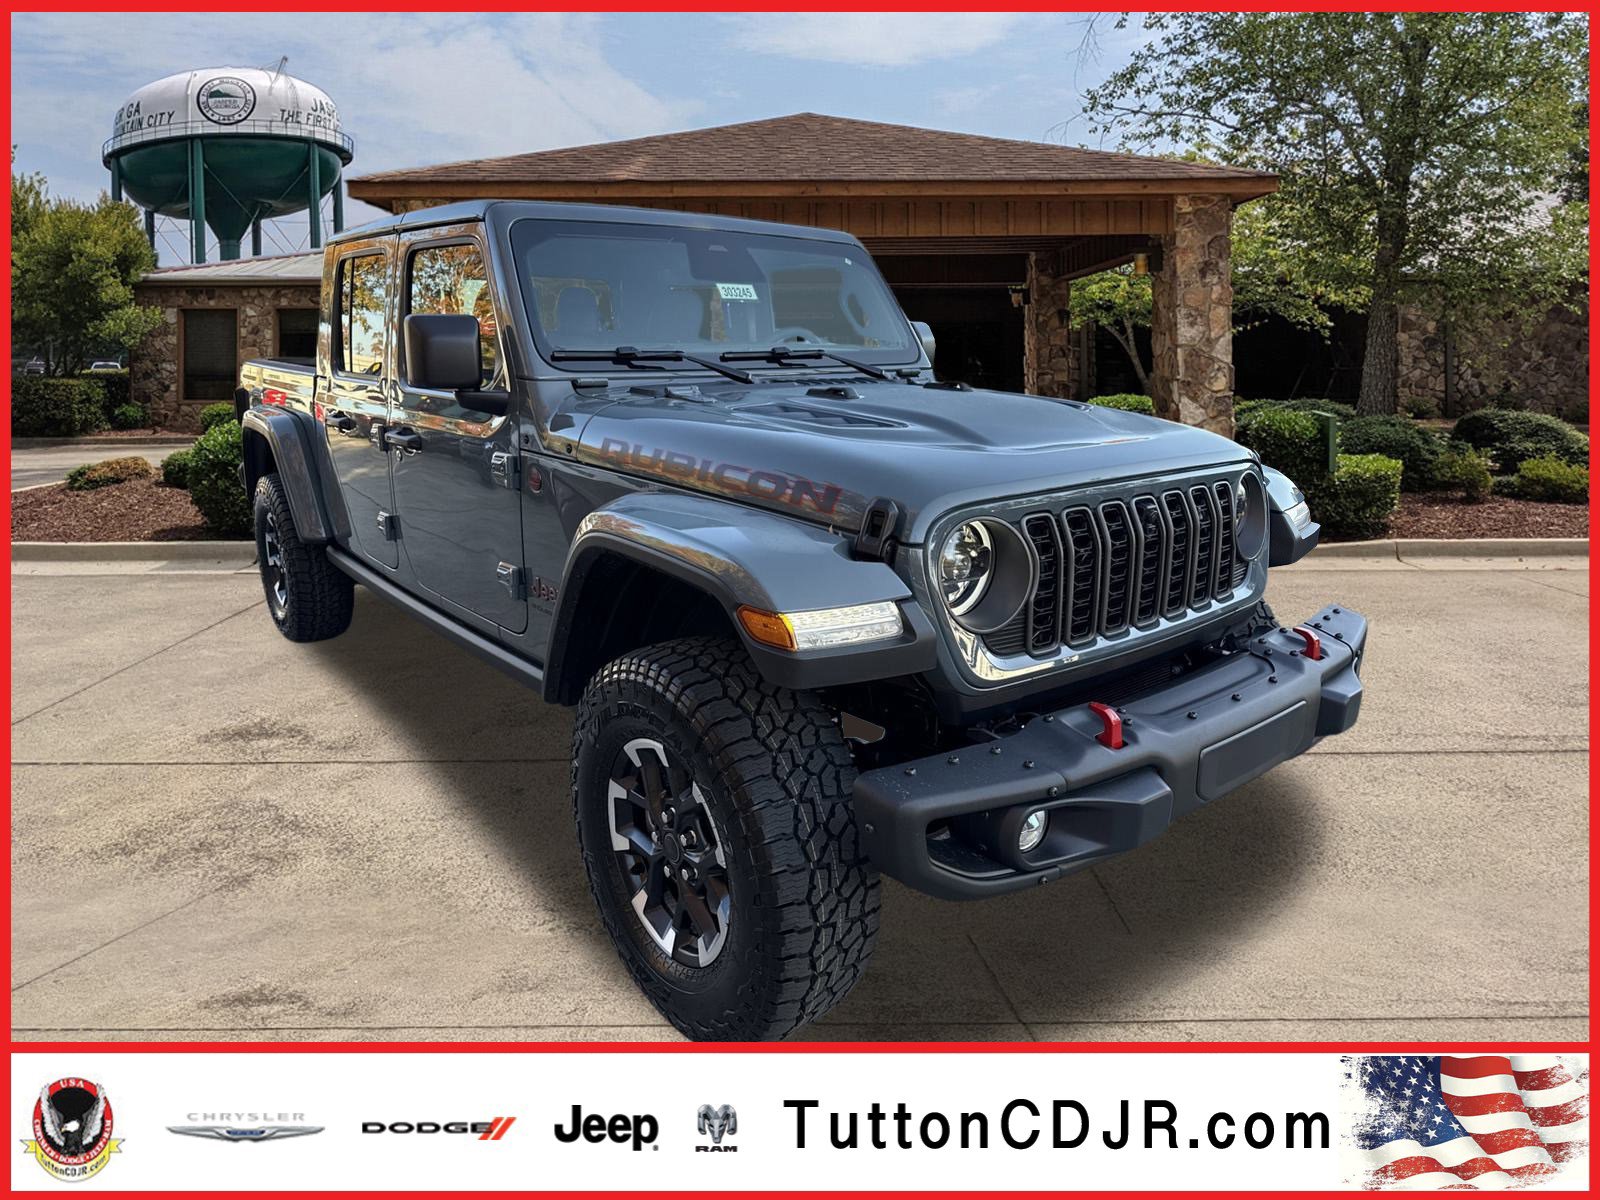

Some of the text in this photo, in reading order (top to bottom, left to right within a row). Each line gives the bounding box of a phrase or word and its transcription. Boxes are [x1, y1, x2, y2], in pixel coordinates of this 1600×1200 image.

[126, 100, 141, 119] GA
[280, 108, 302, 124] THE
[147, 110, 176, 128] CITY
[721, 286, 753, 298] 303245
[599, 437, 843, 514] RUBICON
